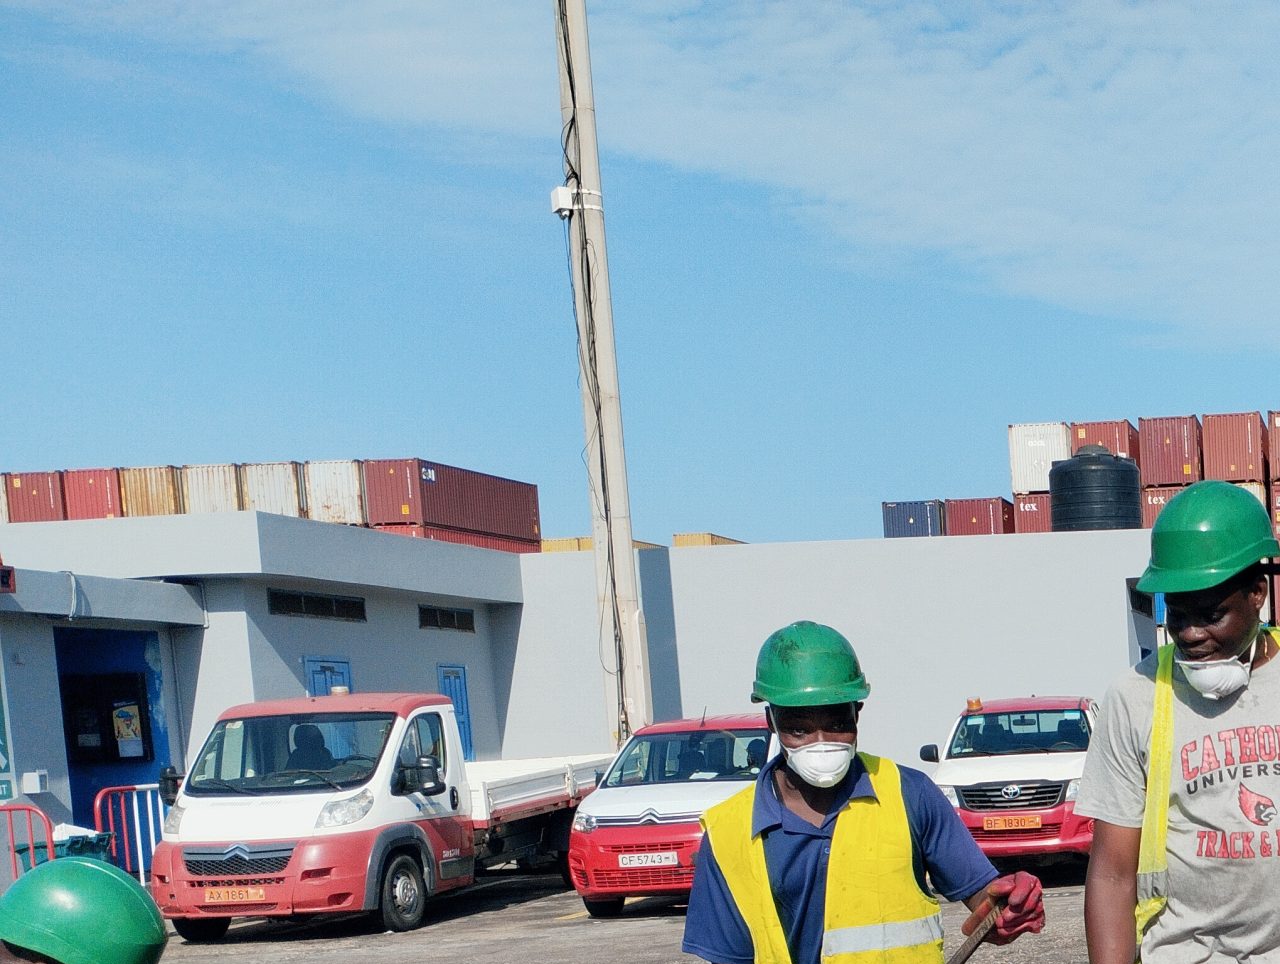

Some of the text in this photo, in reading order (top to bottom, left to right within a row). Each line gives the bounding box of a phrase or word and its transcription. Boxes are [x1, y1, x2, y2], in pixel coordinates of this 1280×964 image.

[1148, 496, 1165, 505] tex
[1020, 502, 1038, 511] tex
[1003, 818, 1026, 828] 1830
[1196, 831, 1255, 859] TRACK
[1260, 831, 1272, 858] &
[621, 854, 663, 866] CF 5743
[208, 890, 222, 900] AX
